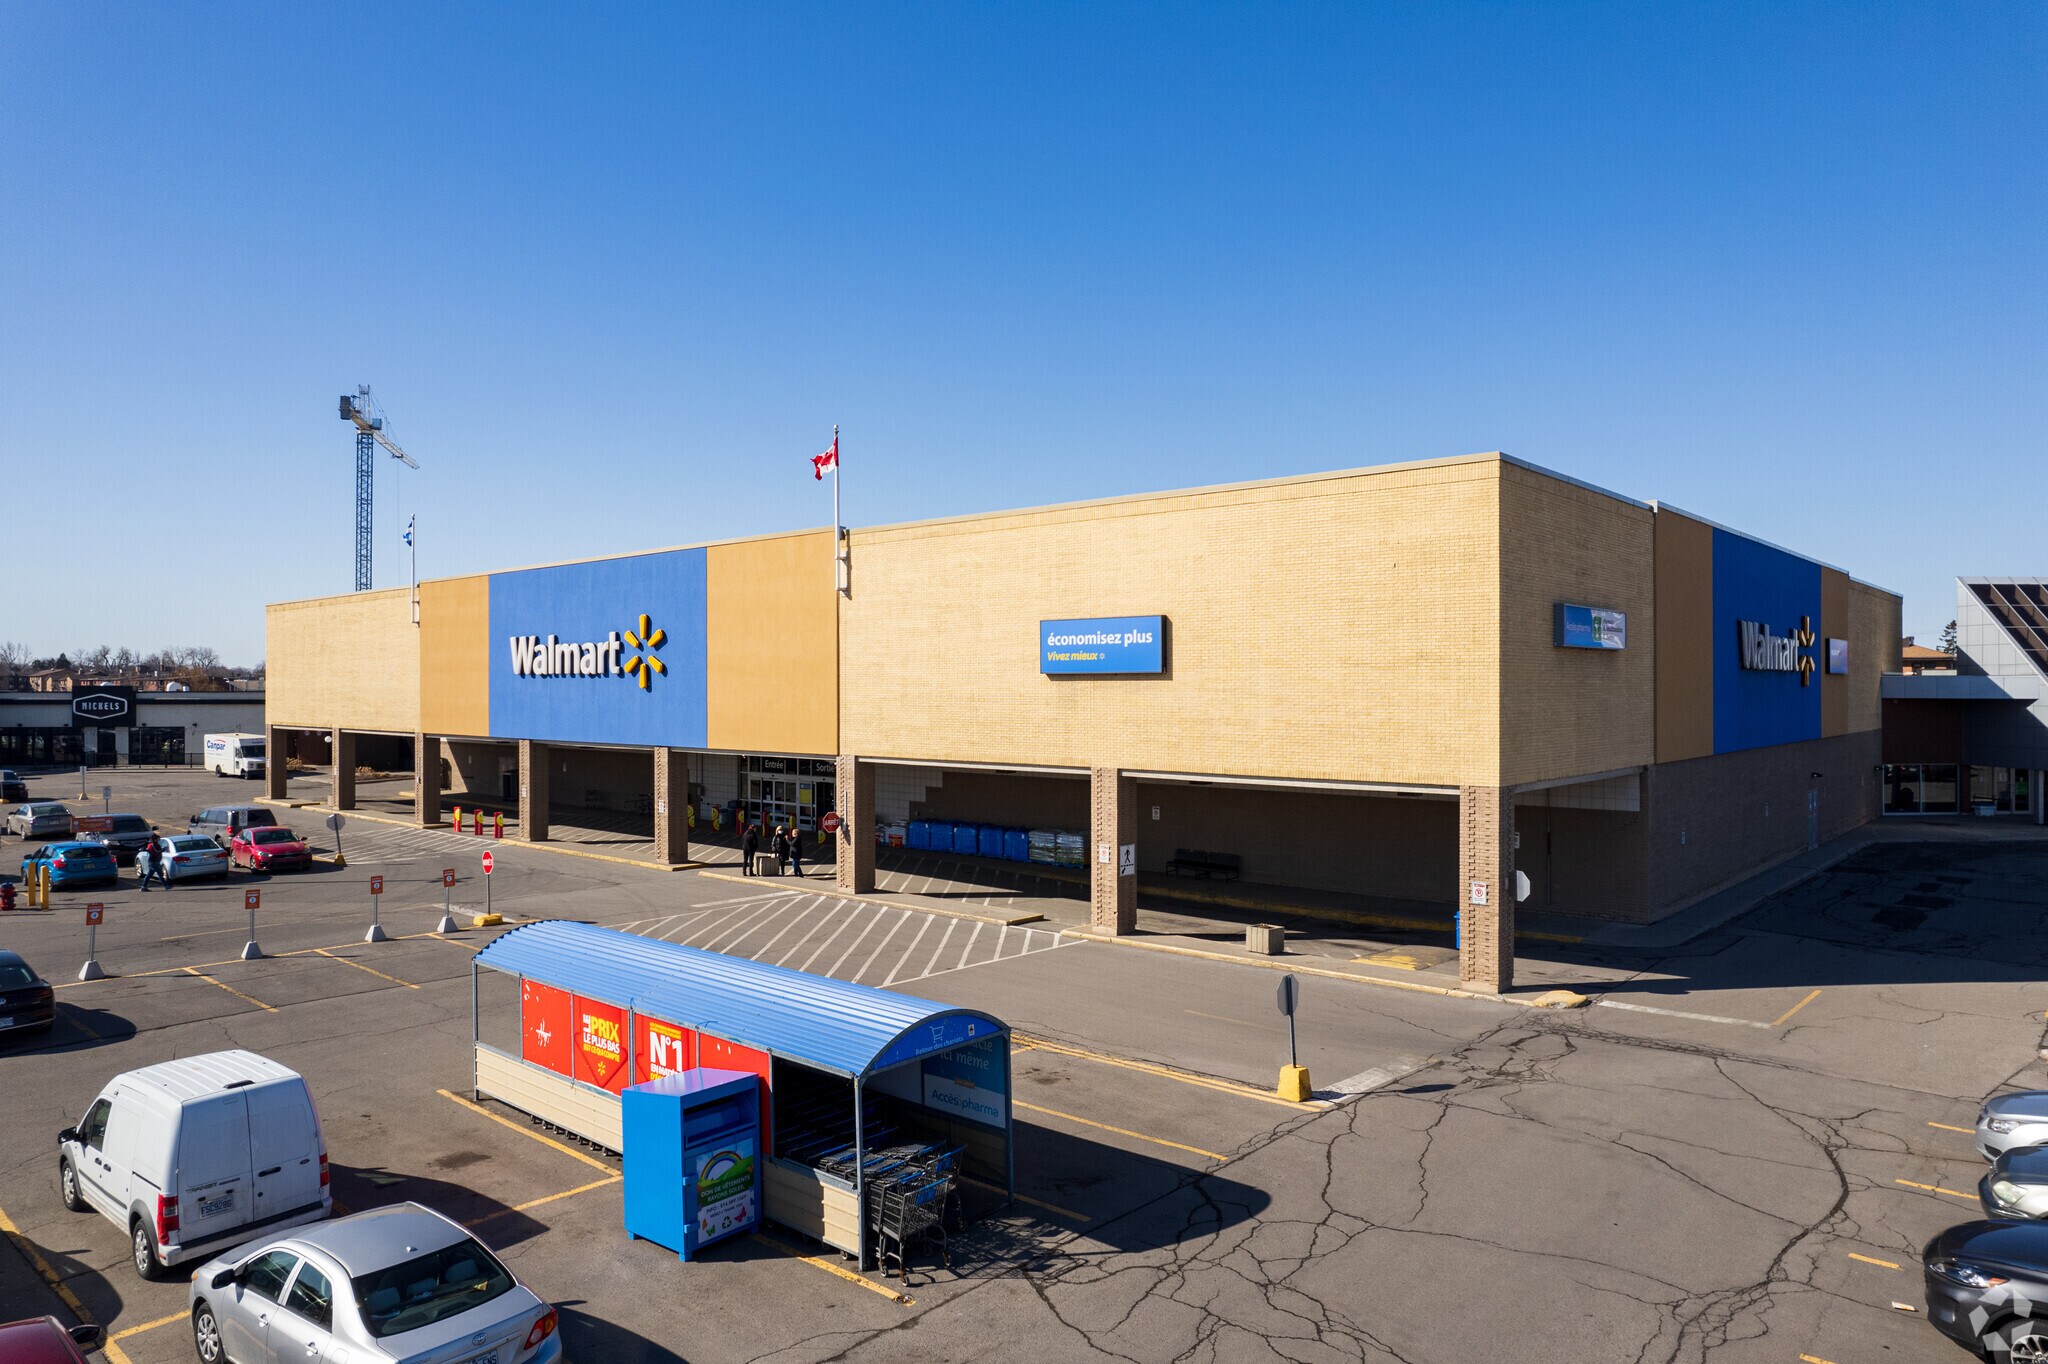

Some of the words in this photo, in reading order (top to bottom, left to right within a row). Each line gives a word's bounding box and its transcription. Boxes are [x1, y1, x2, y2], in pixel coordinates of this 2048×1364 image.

[1047, 631, 1122, 646] économisez
[1124, 629, 1153, 647] plus
[1741, 620, 1800, 671] Walmart
[510, 631, 620, 675] Walmart
[1047, 651, 1070, 660] Vivez
[1071, 651, 1098, 660] mieux
[206, 740, 225, 751] Canpar
[765, 760, 784, 769] Entrée
[816, 763, 835, 773] Sortie
[824, 818, 839, 826] ARRÊT
[583, 1014, 591, 1033] LE
[590, 1015, 619, 1043] PRIX
[583, 1032, 592, 1044] LE
[591, 1035, 607, 1049] PLUS
[607, 1040, 620, 1054] BAS
[915, 1045, 933, 1055] Retour
[934, 1041, 943, 1050] des
[944, 1036, 964, 1047] chariots
[956, 1052, 989, 1070] même
[932, 1089, 959, 1105] Accès
[961, 1098, 999, 1118] pharma
[701, 1189, 713, 1198] DON
[707, 1190, 728, 1202] RAYONS
